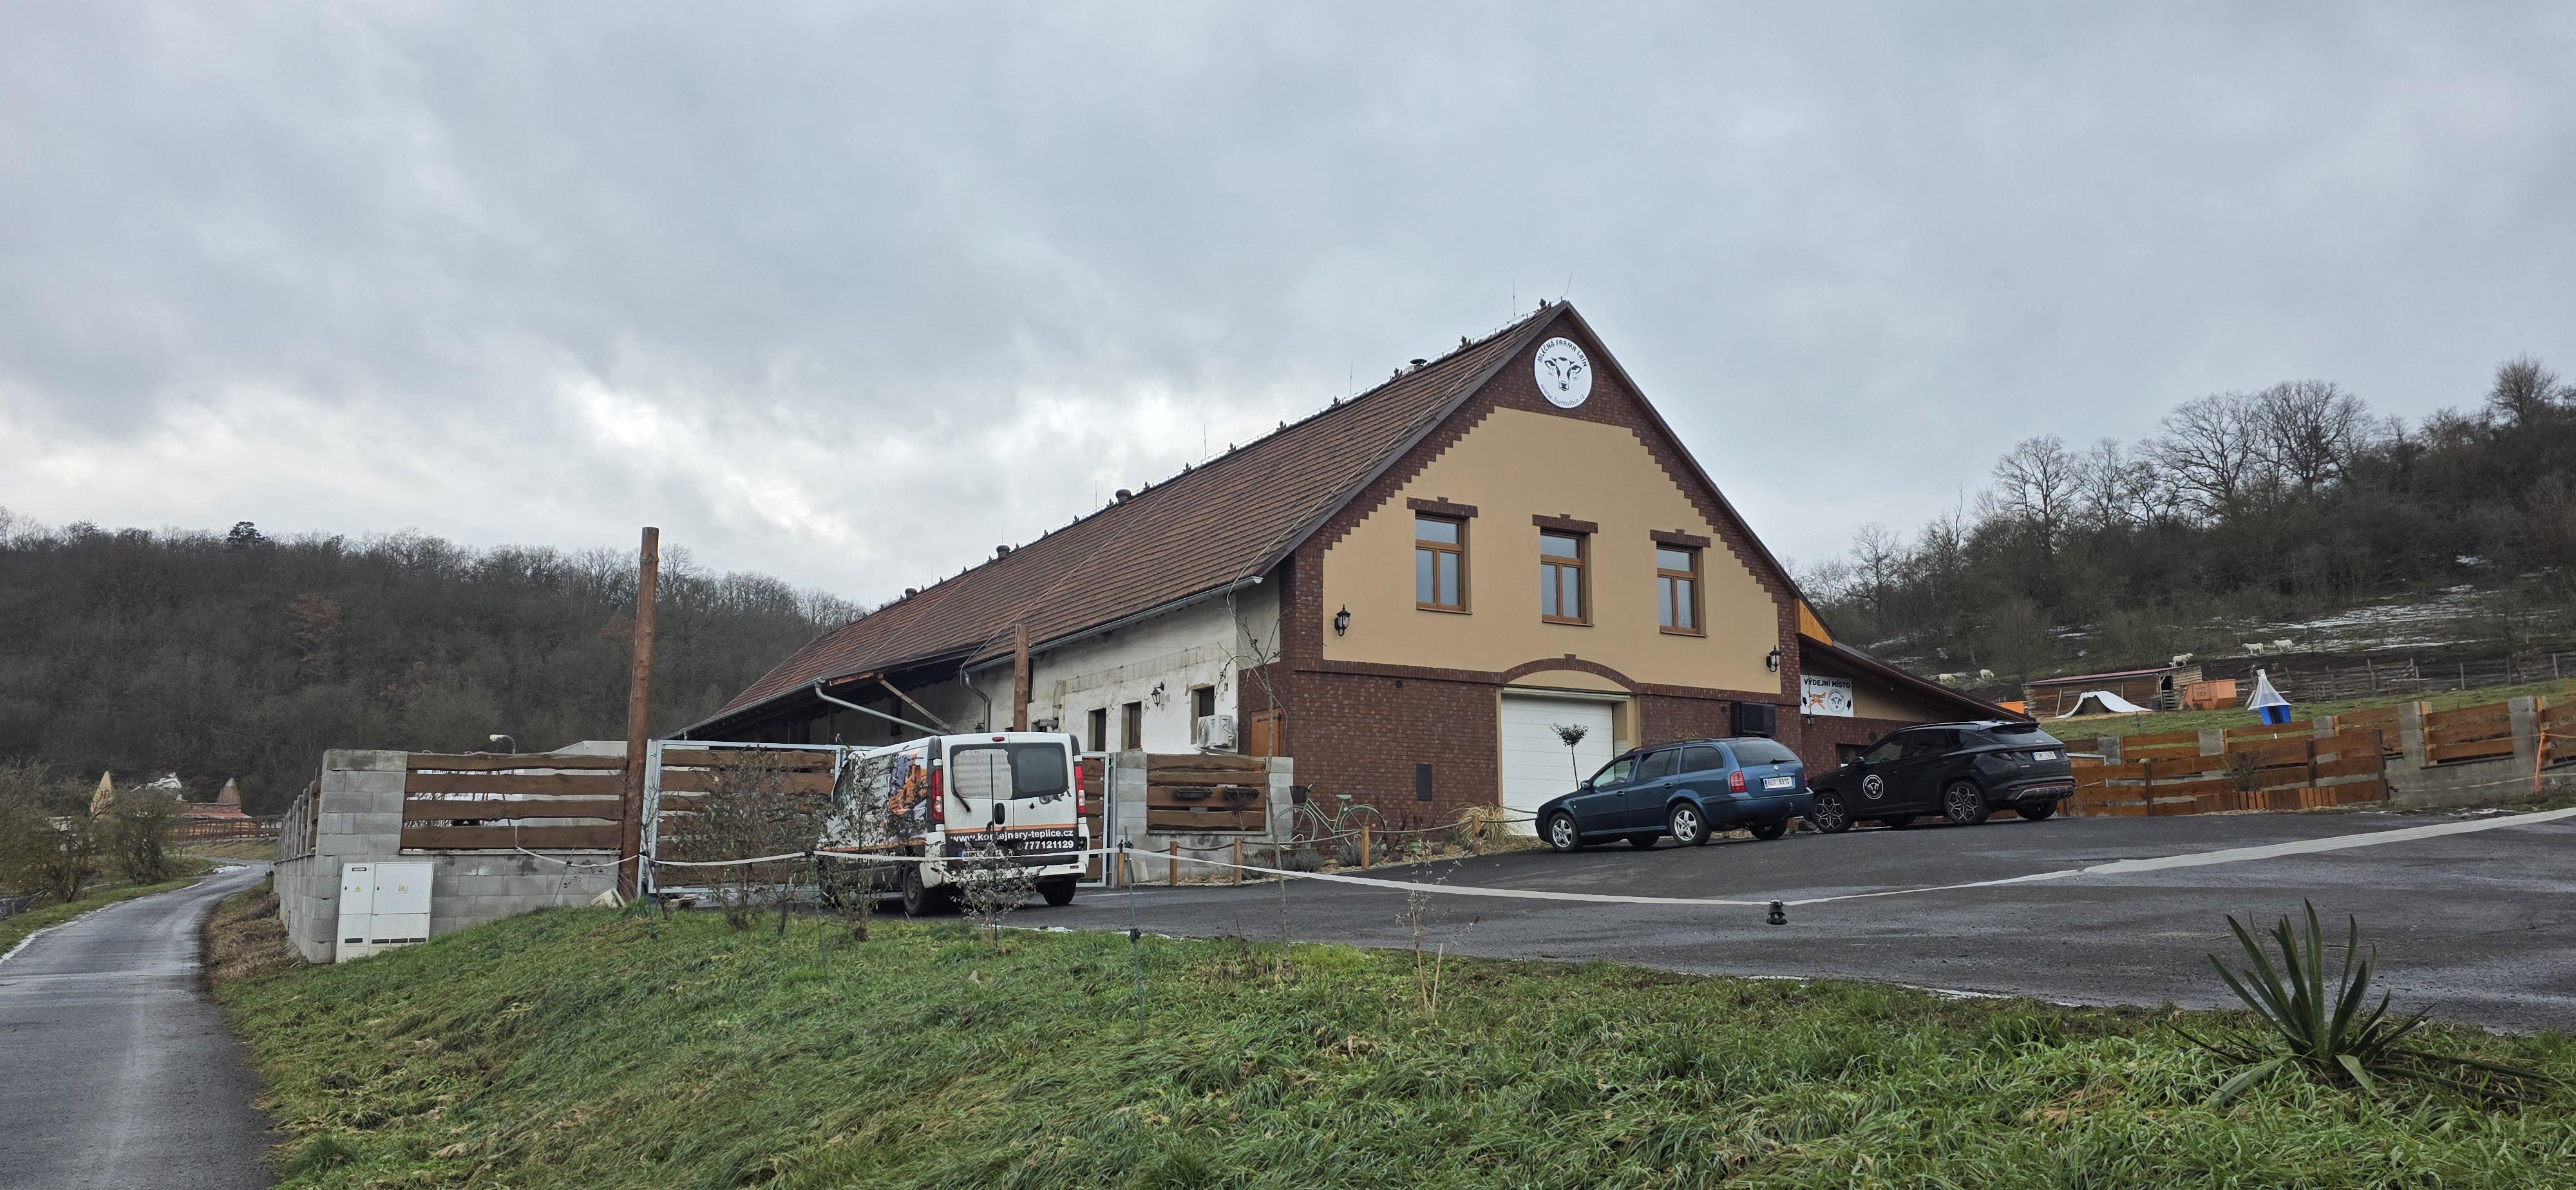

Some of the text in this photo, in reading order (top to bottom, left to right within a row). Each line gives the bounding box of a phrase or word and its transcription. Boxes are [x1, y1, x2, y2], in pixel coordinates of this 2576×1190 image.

[1537, 339, 1588, 367] MLÉČNÁ FARMA LBÍN
[1540, 383, 1585, 406] www.farmalbin.cz
[1803, 677, 1851, 688] VÝDEJNÍ MÍSTO
[1024, 840, 1074, 850] 777121129
